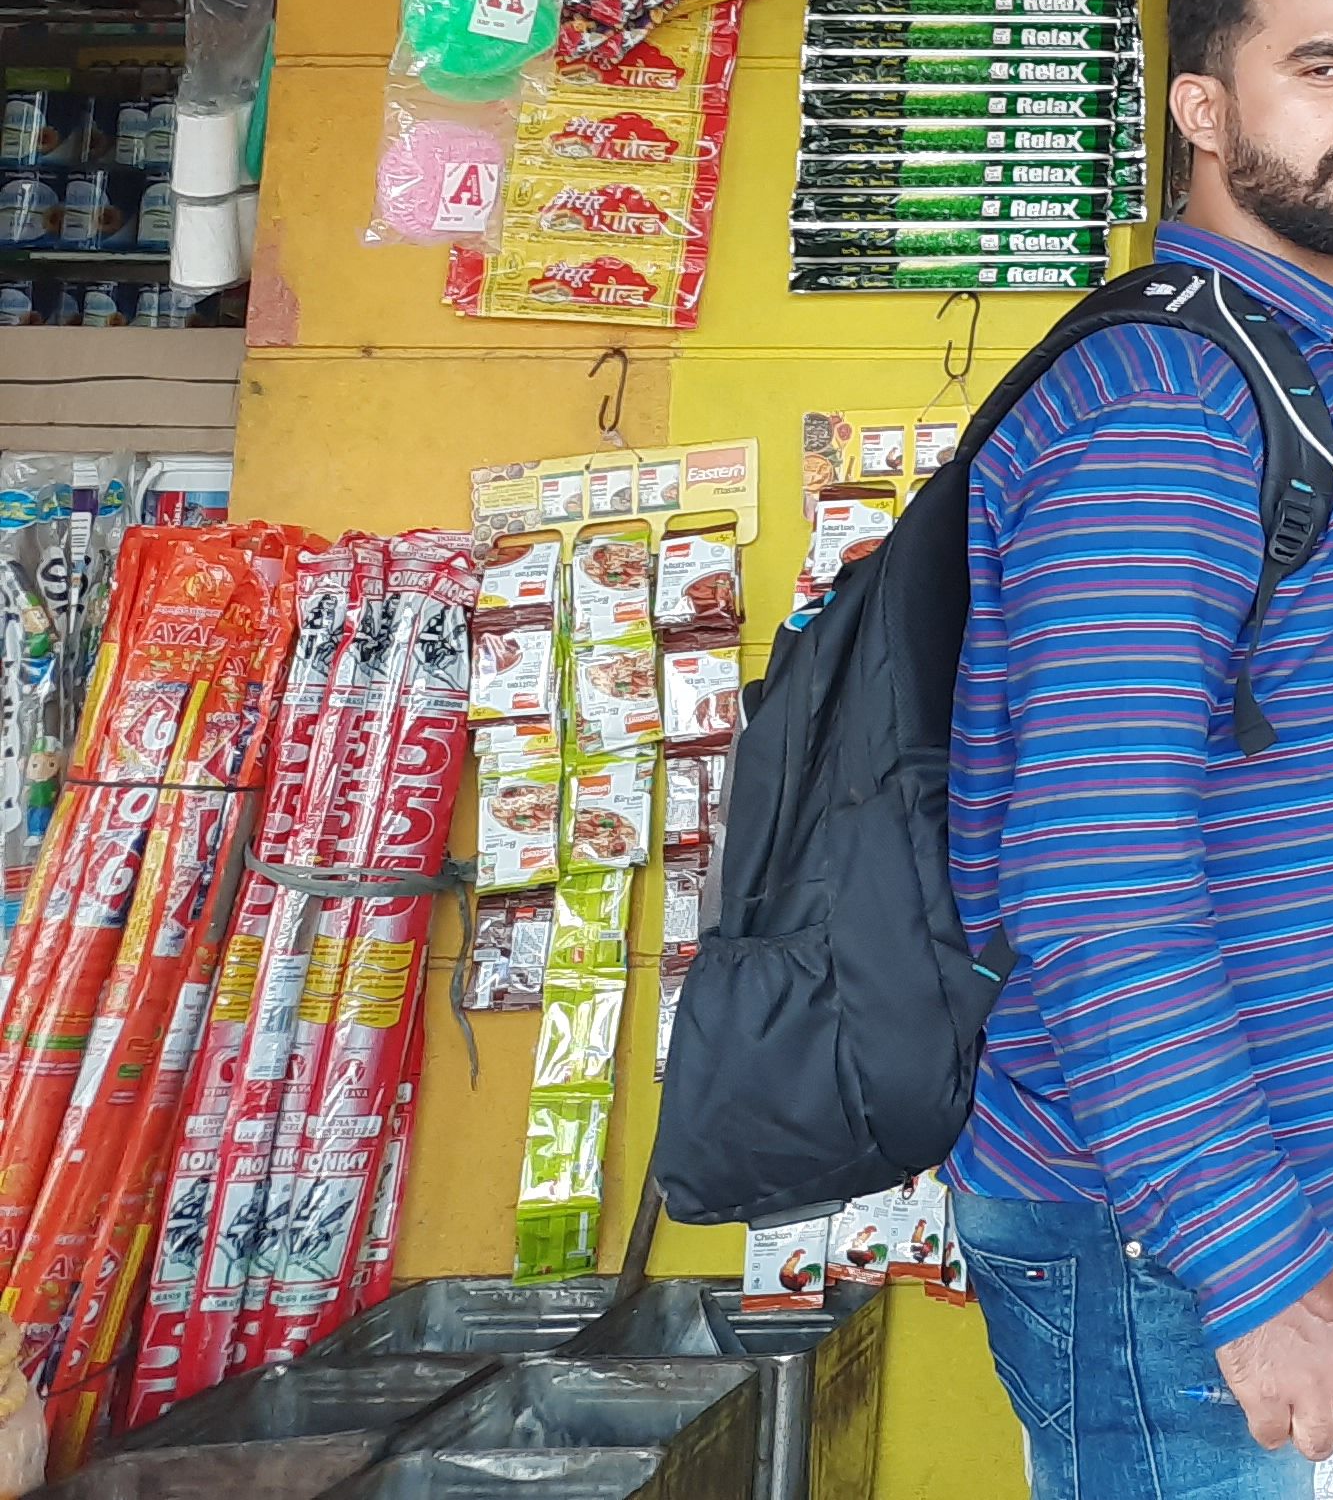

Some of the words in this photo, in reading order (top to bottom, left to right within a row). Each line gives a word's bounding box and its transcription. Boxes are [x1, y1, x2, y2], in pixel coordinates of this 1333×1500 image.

[1020, 28, 1089, 48] Relax
[1018, 61, 1087, 82] Relax
[1016, 96, 1085, 117] Relax
[1014, 130, 1082, 151] Relax
[1012, 164, 1080, 185] Relax
[1010, 198, 1078, 219] Relax
[1009, 233, 1078, 253] Relax
[1006, 266, 1077, 287] Relax
[687, 465, 747, 483] Eastern
